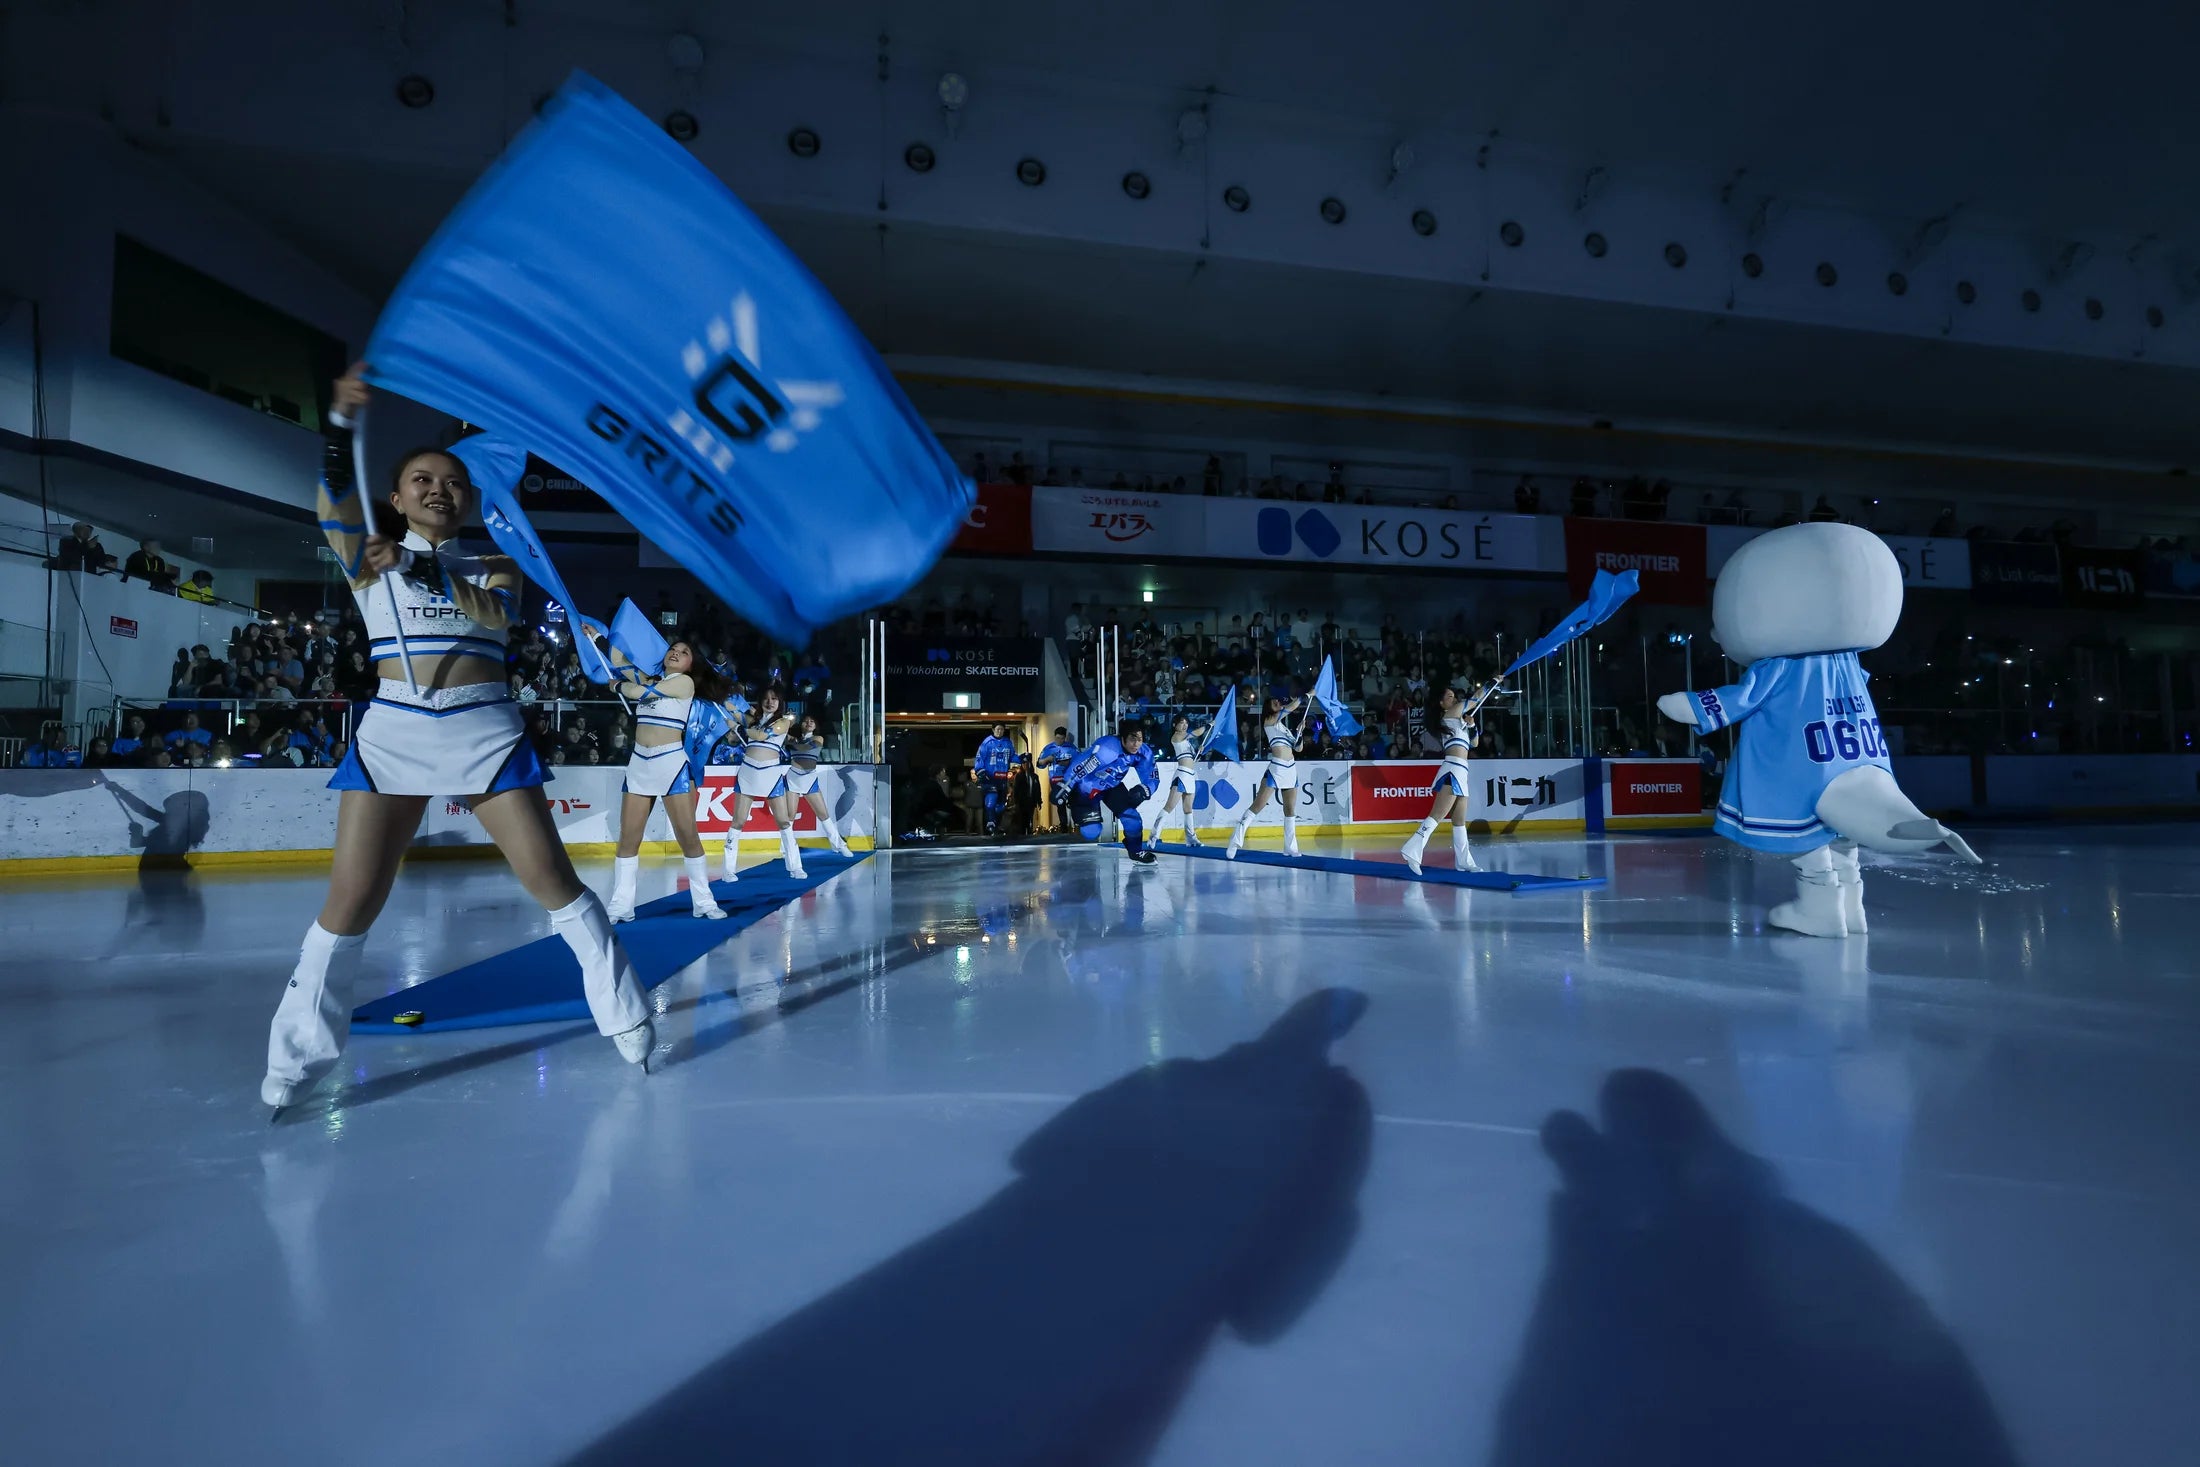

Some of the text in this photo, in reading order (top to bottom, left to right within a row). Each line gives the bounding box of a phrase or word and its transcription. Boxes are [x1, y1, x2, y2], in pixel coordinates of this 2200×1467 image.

[586, 401, 746, 537] GRITS
[1088, 513, 1150, 531] エバラ
[1361, 516, 1493, 560] KOSÉ
[1595, 552, 1680, 572] FRONTIER
[407, 607, 472, 620] TOPA
[955, 648, 995, 661] KOSÉ
[906, 665, 961, 676] Yokohama
[965, 666, 998, 676] SKATE
[999, 666, 1039, 676] CENTER
[1373, 787, 1433, 798] FRONTIER
[1486, 775, 1556, 807] バニカ
[1630, 783, 1683, 794] FRONTIER
